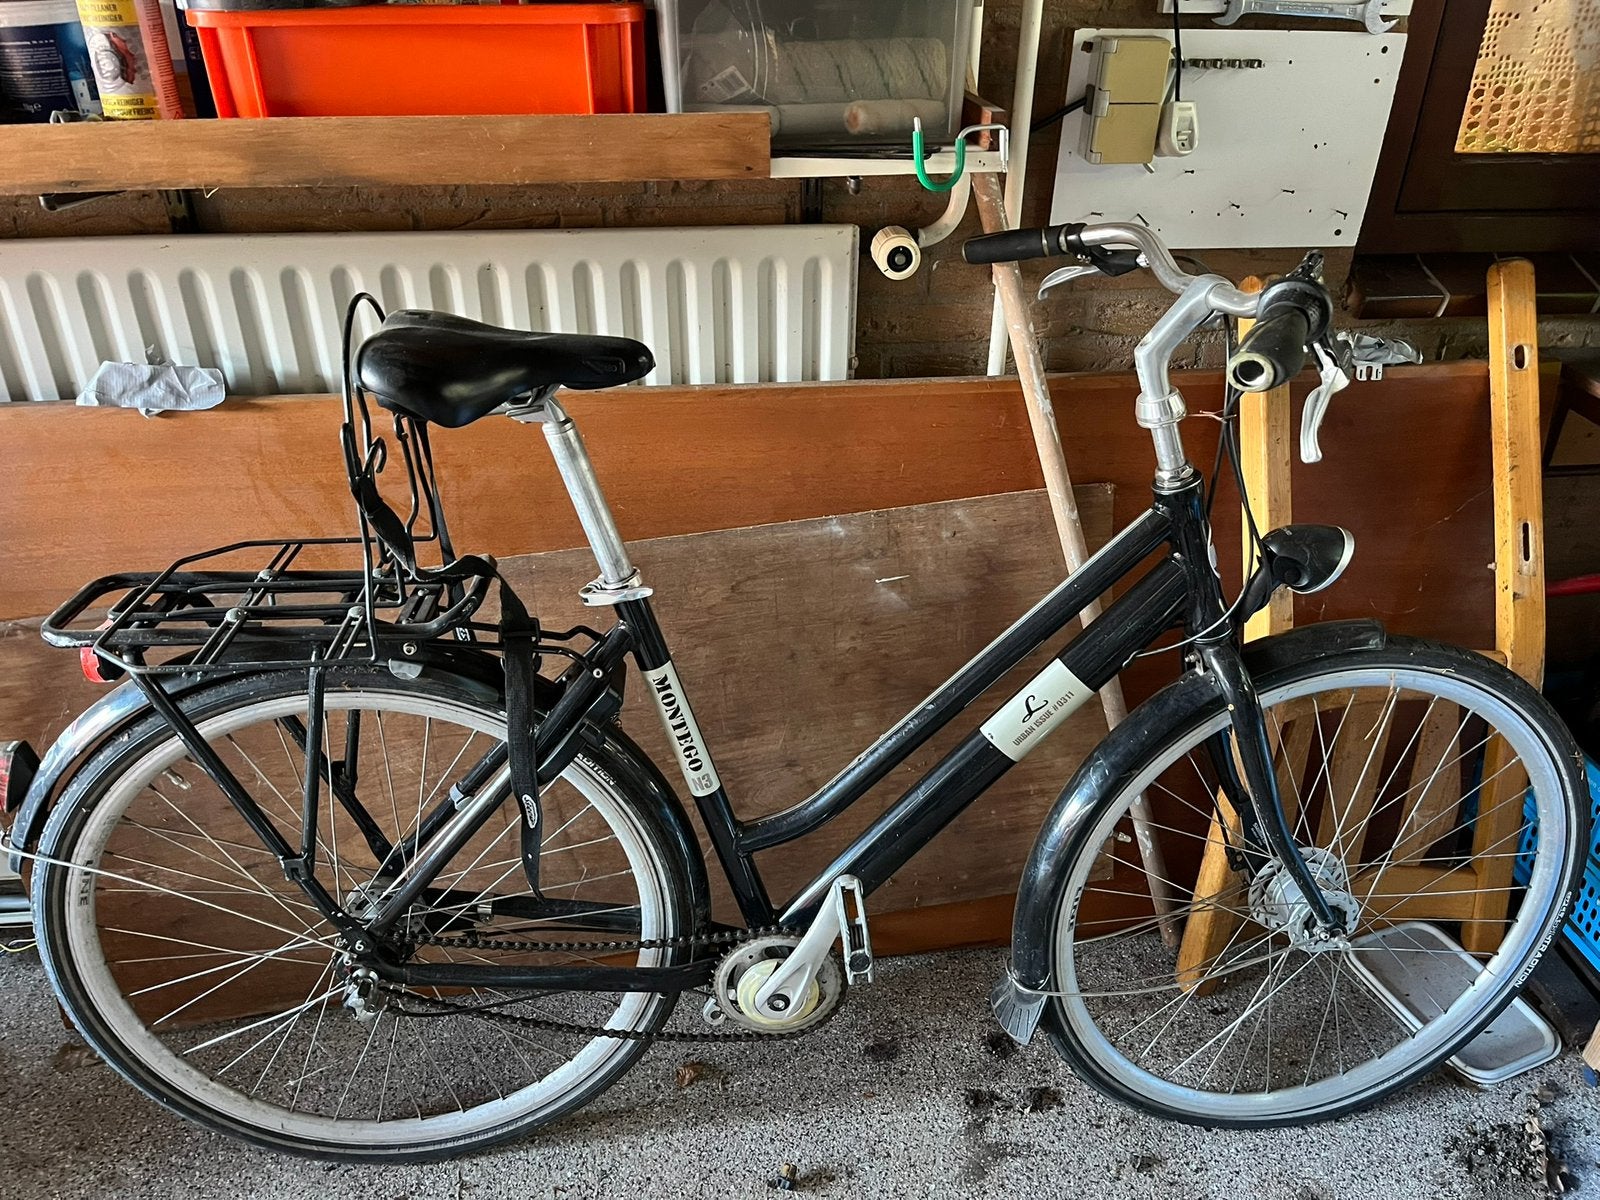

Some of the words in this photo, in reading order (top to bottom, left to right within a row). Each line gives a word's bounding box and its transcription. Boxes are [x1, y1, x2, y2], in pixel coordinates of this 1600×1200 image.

[653, 674, 703, 772] MONTEGO
[1012, 725, 1036, 746] URBAN
[1034, 709, 1054, 729] ISSUE
